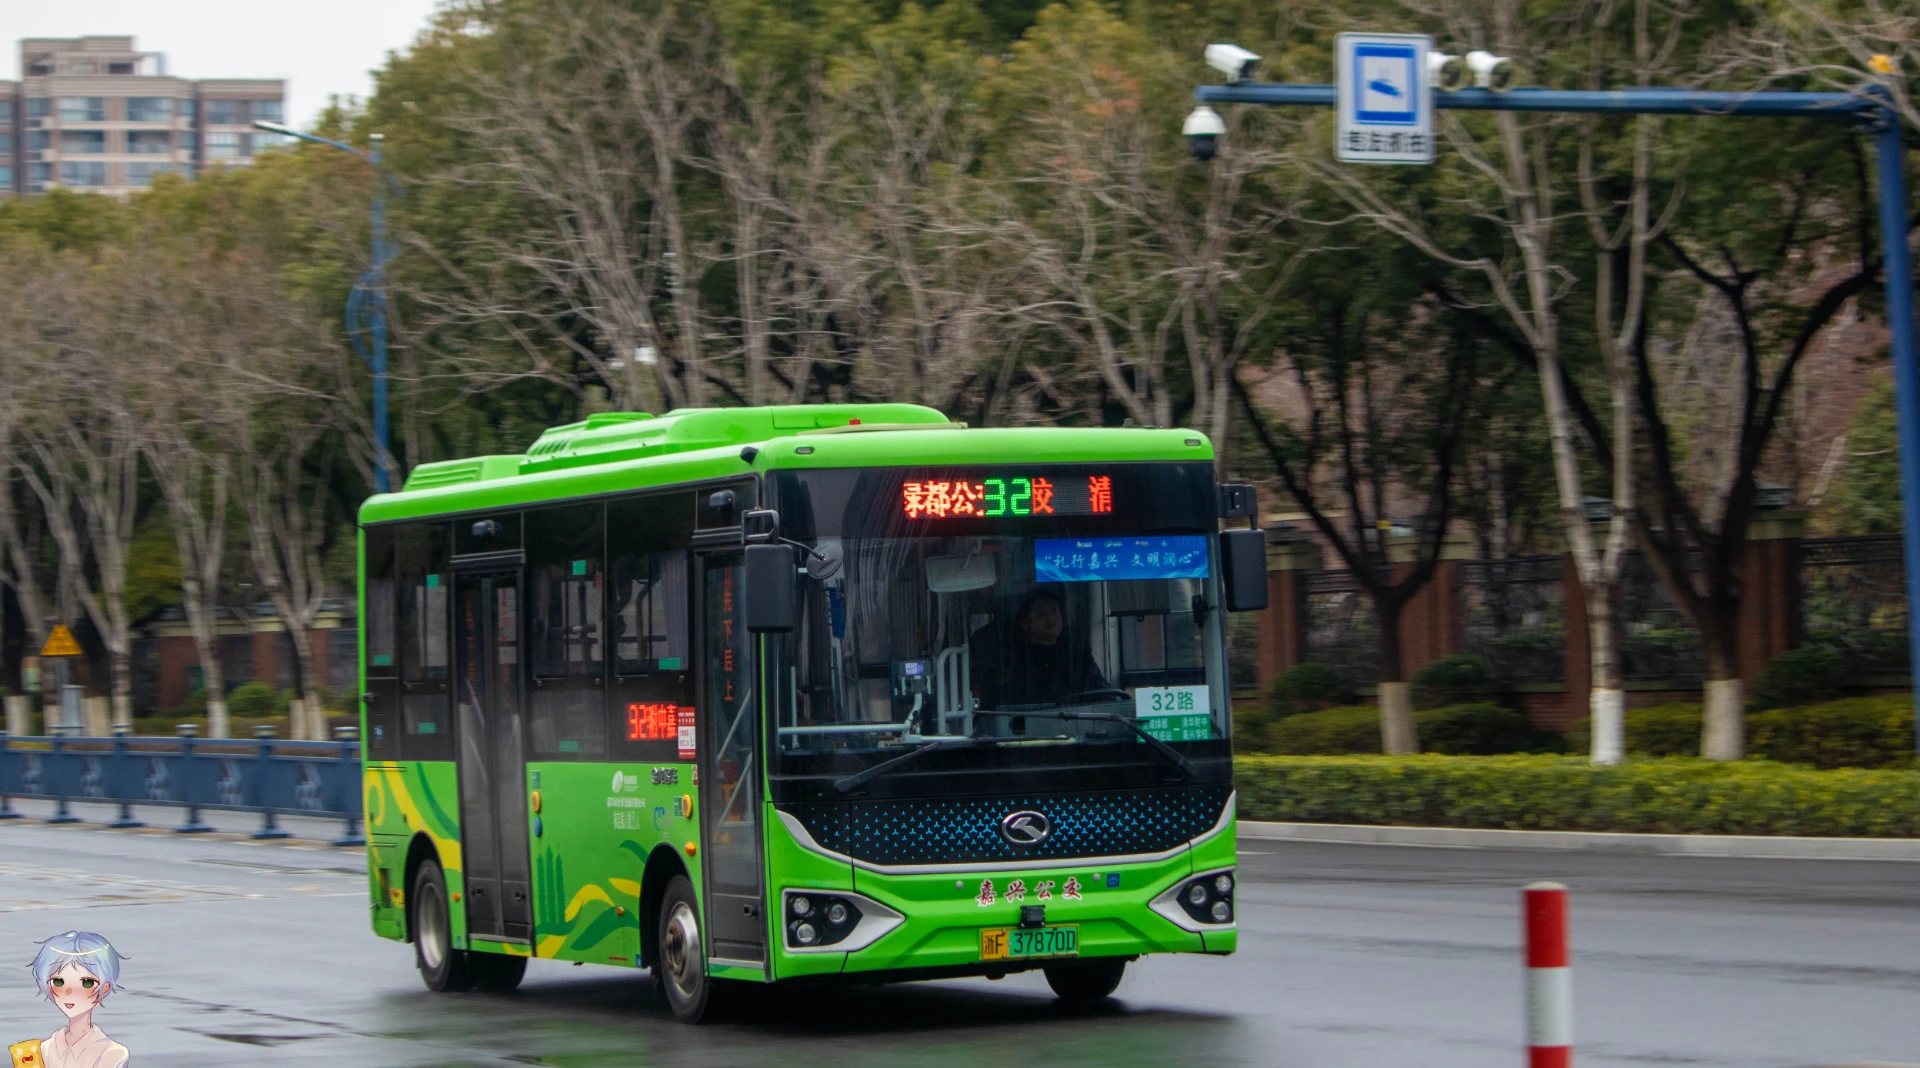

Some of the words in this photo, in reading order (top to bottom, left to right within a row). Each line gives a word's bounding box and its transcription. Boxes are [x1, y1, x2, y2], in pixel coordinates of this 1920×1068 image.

[985, 478, 1031, 516] 32
[1151, 691, 1194, 711] 32路
[976, 877, 1082, 906] 嘉兴公交
